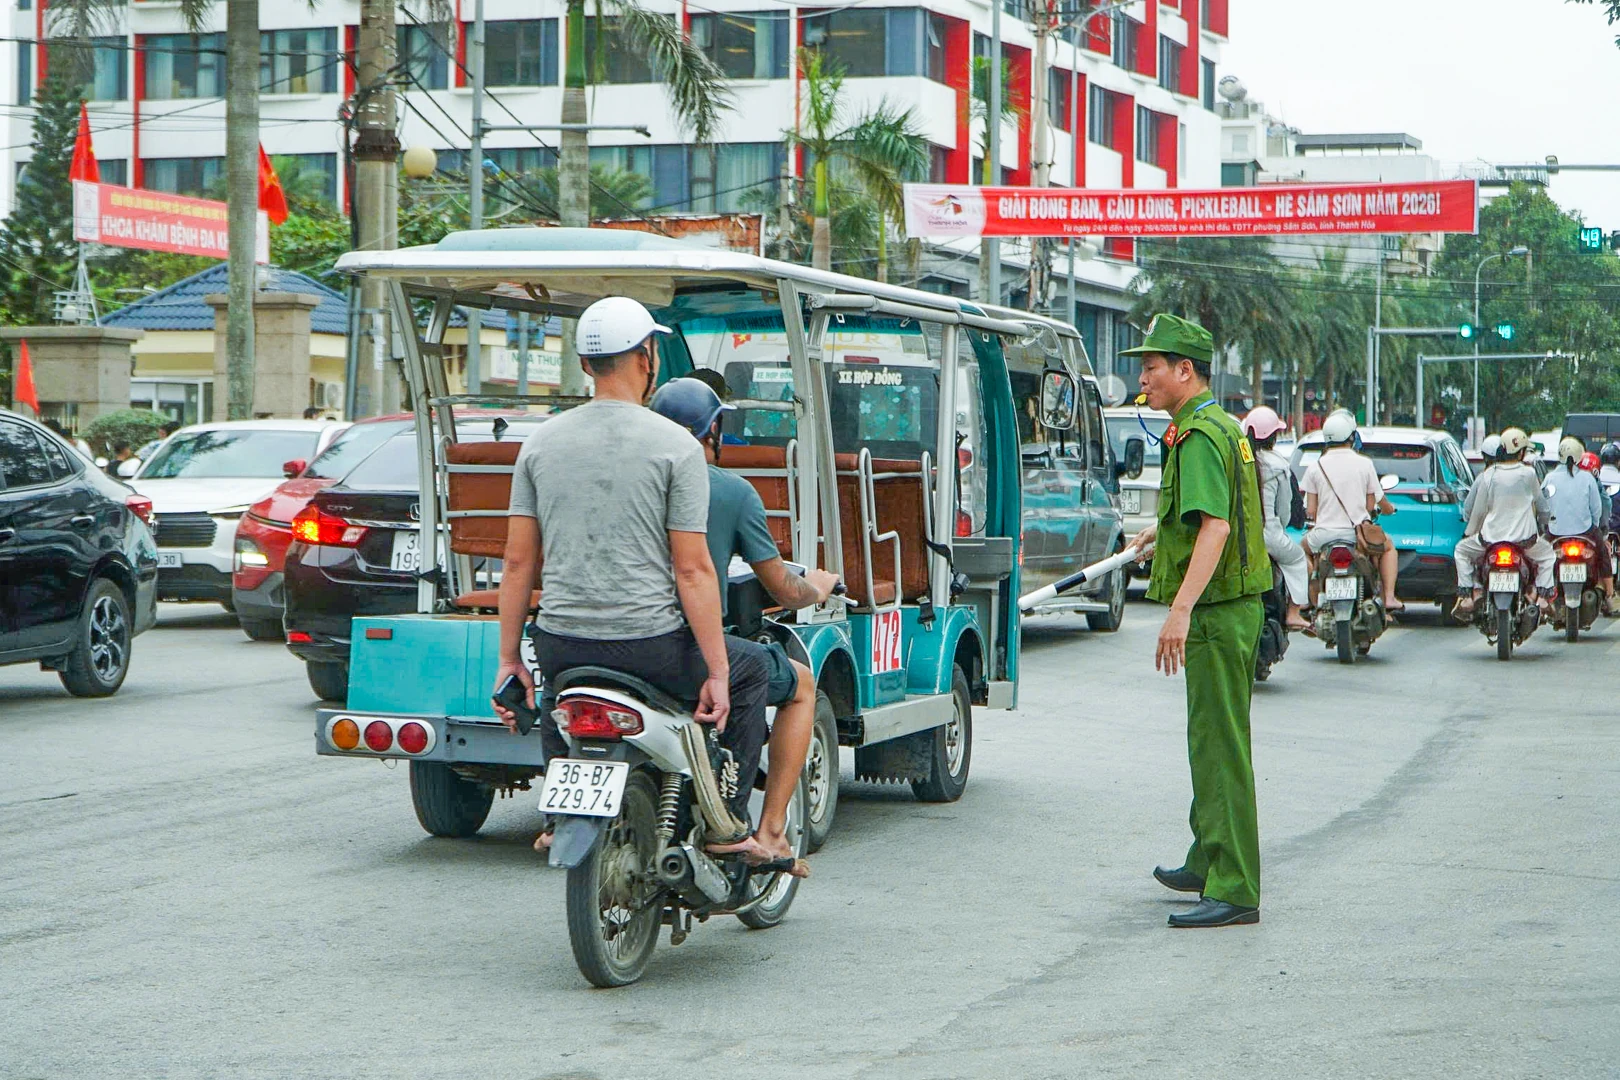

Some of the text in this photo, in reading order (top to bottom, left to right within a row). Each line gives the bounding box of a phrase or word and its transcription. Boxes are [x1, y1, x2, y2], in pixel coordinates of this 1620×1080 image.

[999, 192, 1027, 219] GIẢI
[1107, 192, 1134, 219] CẦU
[1182, 195, 1262, 219] PICKLEBALL
[1276, 192, 1293, 217] HÈ
[1333, 192, 1362, 217] SƠN
[1366, 190, 1398, 216] NĂM
[1402, 191, 1441, 215] 2026!
[102, 215, 229, 250] KHOA KHÁM BỆNH ĐA KH
[1233, 223, 1252, 231] TDTT
[1336, 220, 1359, 230] Thanh
[1581, 229, 1599, 247] 49
[780, 368, 793, 380] ĐỒN
[838, 366, 902, 388] XE HỢP ĐỒNG
[1121, 491, 1133, 501] 6A
[327, 504, 354, 512] CITY
[873, 611, 900, 672] 472
[558, 764, 615, 786] 36-B7
[546, 787, 613, 812] 229.74
